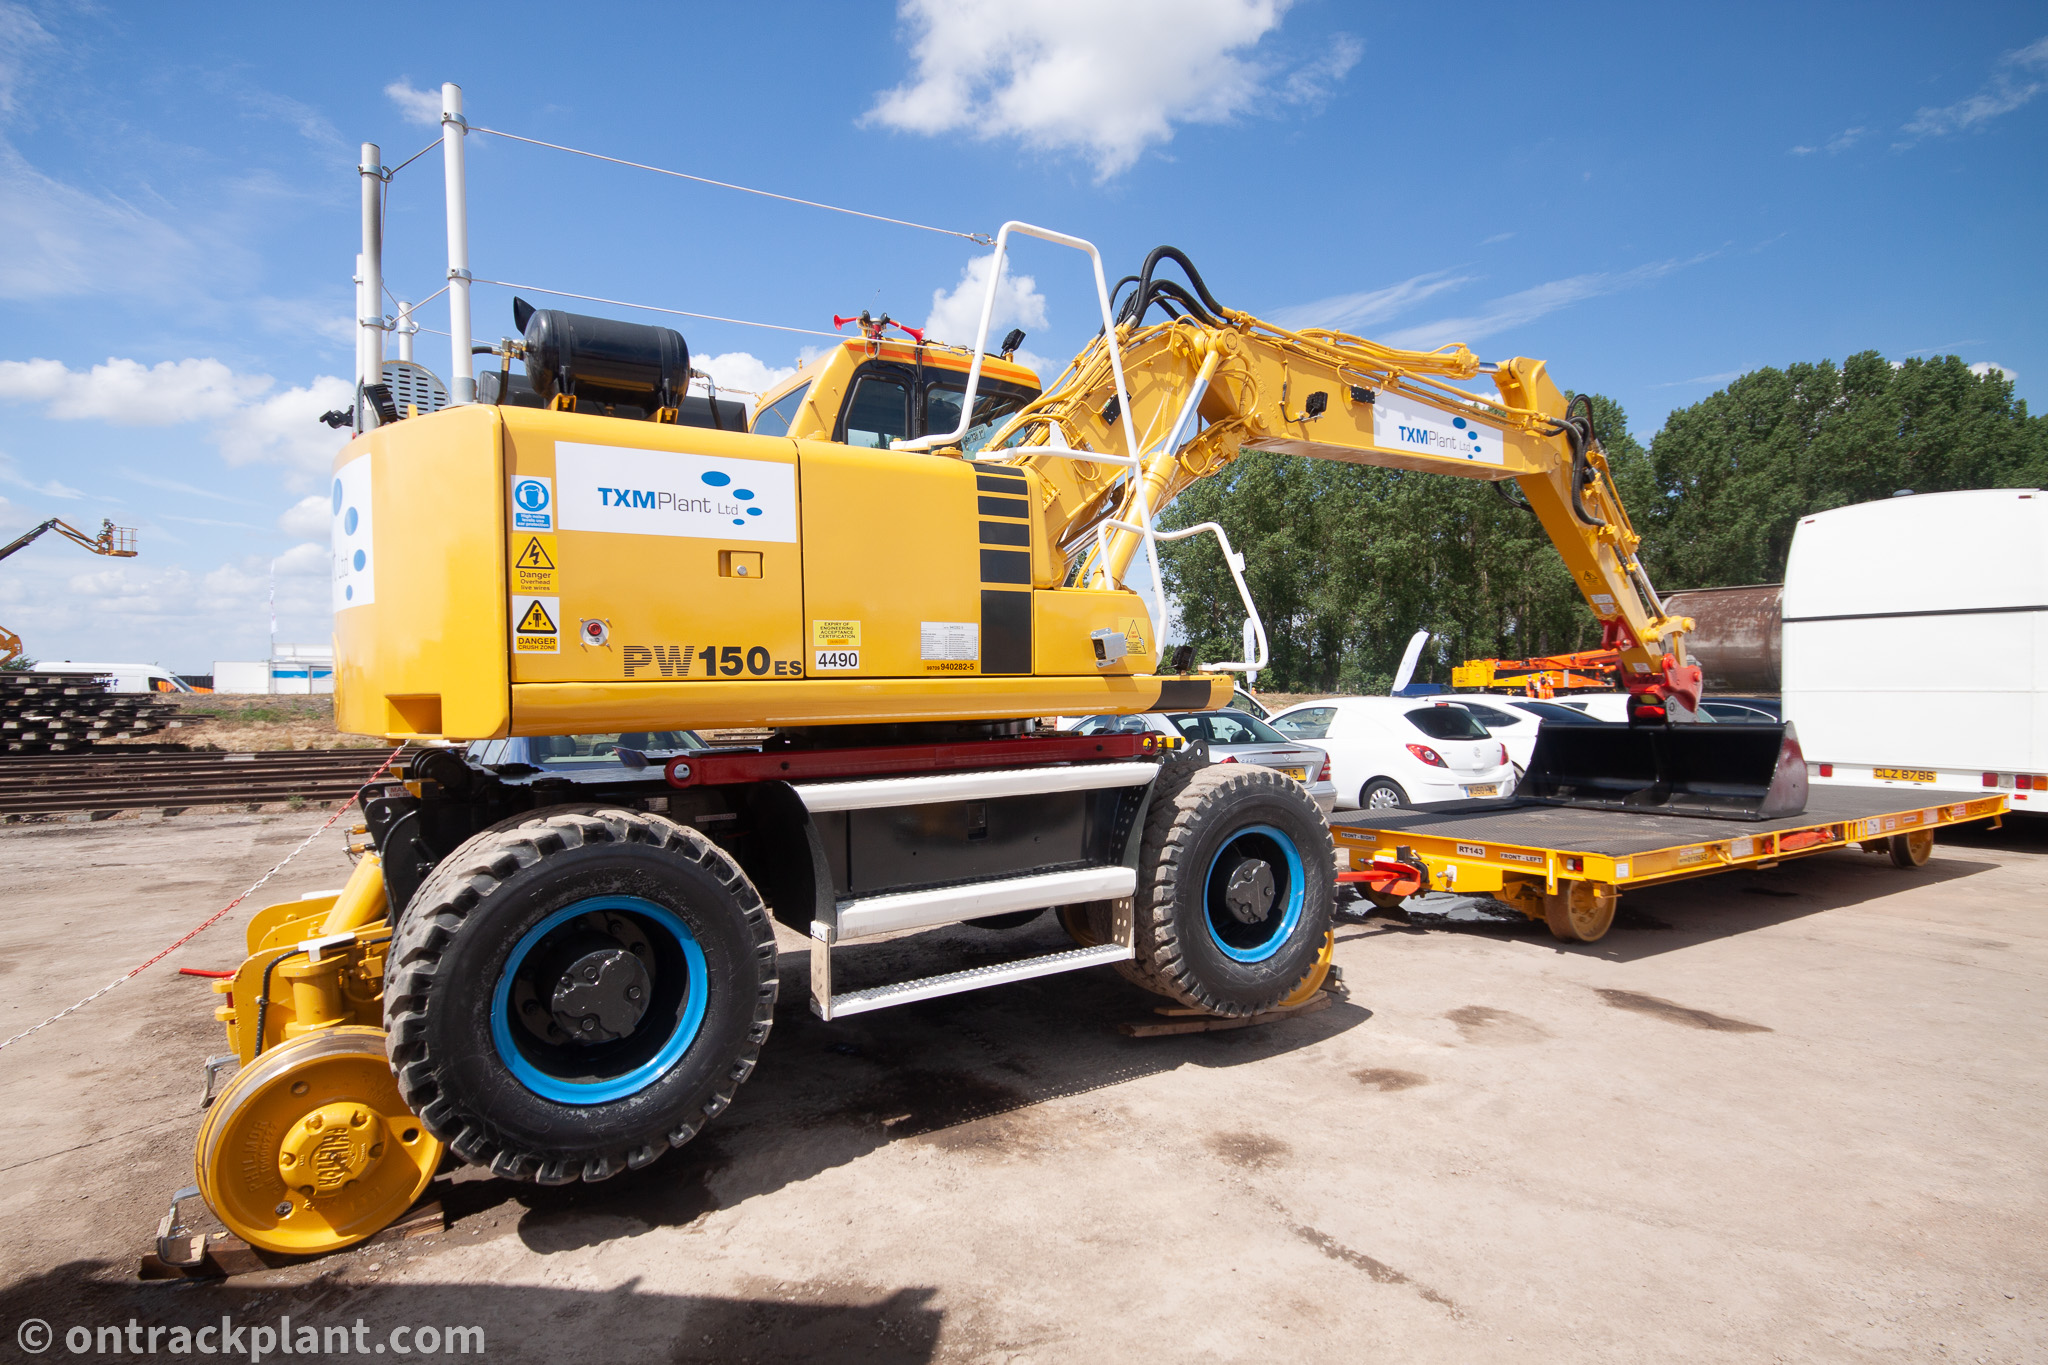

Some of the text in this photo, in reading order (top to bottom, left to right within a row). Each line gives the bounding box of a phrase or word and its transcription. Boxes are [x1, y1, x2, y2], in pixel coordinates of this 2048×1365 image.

[1459, 440, 1471, 452] Ltd
[717, 502, 739, 516] Ltd
[519, 570, 552, 580] Danger
[518, 637, 556, 645] DANGER
[818, 652, 858, 668] 4490
[940, 662, 975, 671] 940282-5
[1875, 768, 1935, 781] CLZ 8786
[1458, 845, 1484, 856] RT143
